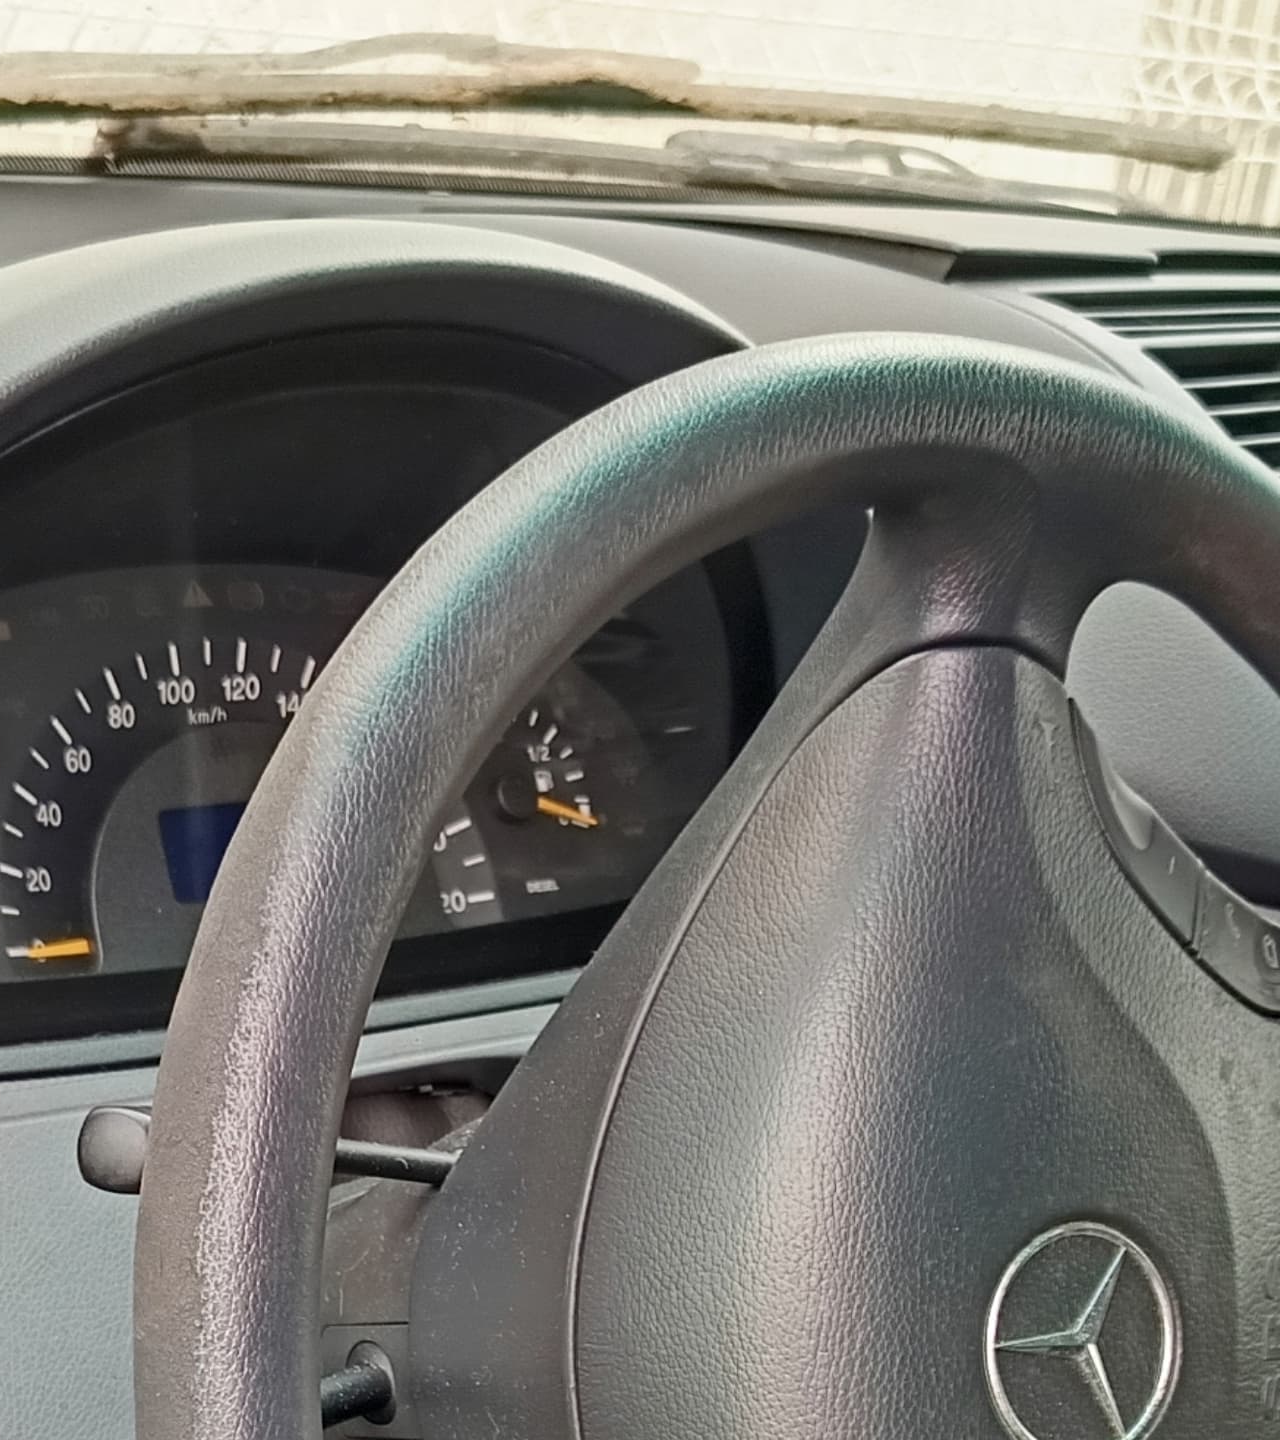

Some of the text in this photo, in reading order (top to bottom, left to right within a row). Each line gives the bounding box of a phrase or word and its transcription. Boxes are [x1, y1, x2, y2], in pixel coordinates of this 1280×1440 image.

[158, 679, 195, 704] 100
[222, 676, 260, 701] 120
[108, 703, 136, 729] 80
[187, 706, 228, 725] km/h
[277, 692, 304, 718] 14
[65, 748, 91, 773] 60
[36, 802, 62, 827] 40
[26, 867, 51, 893] 20
